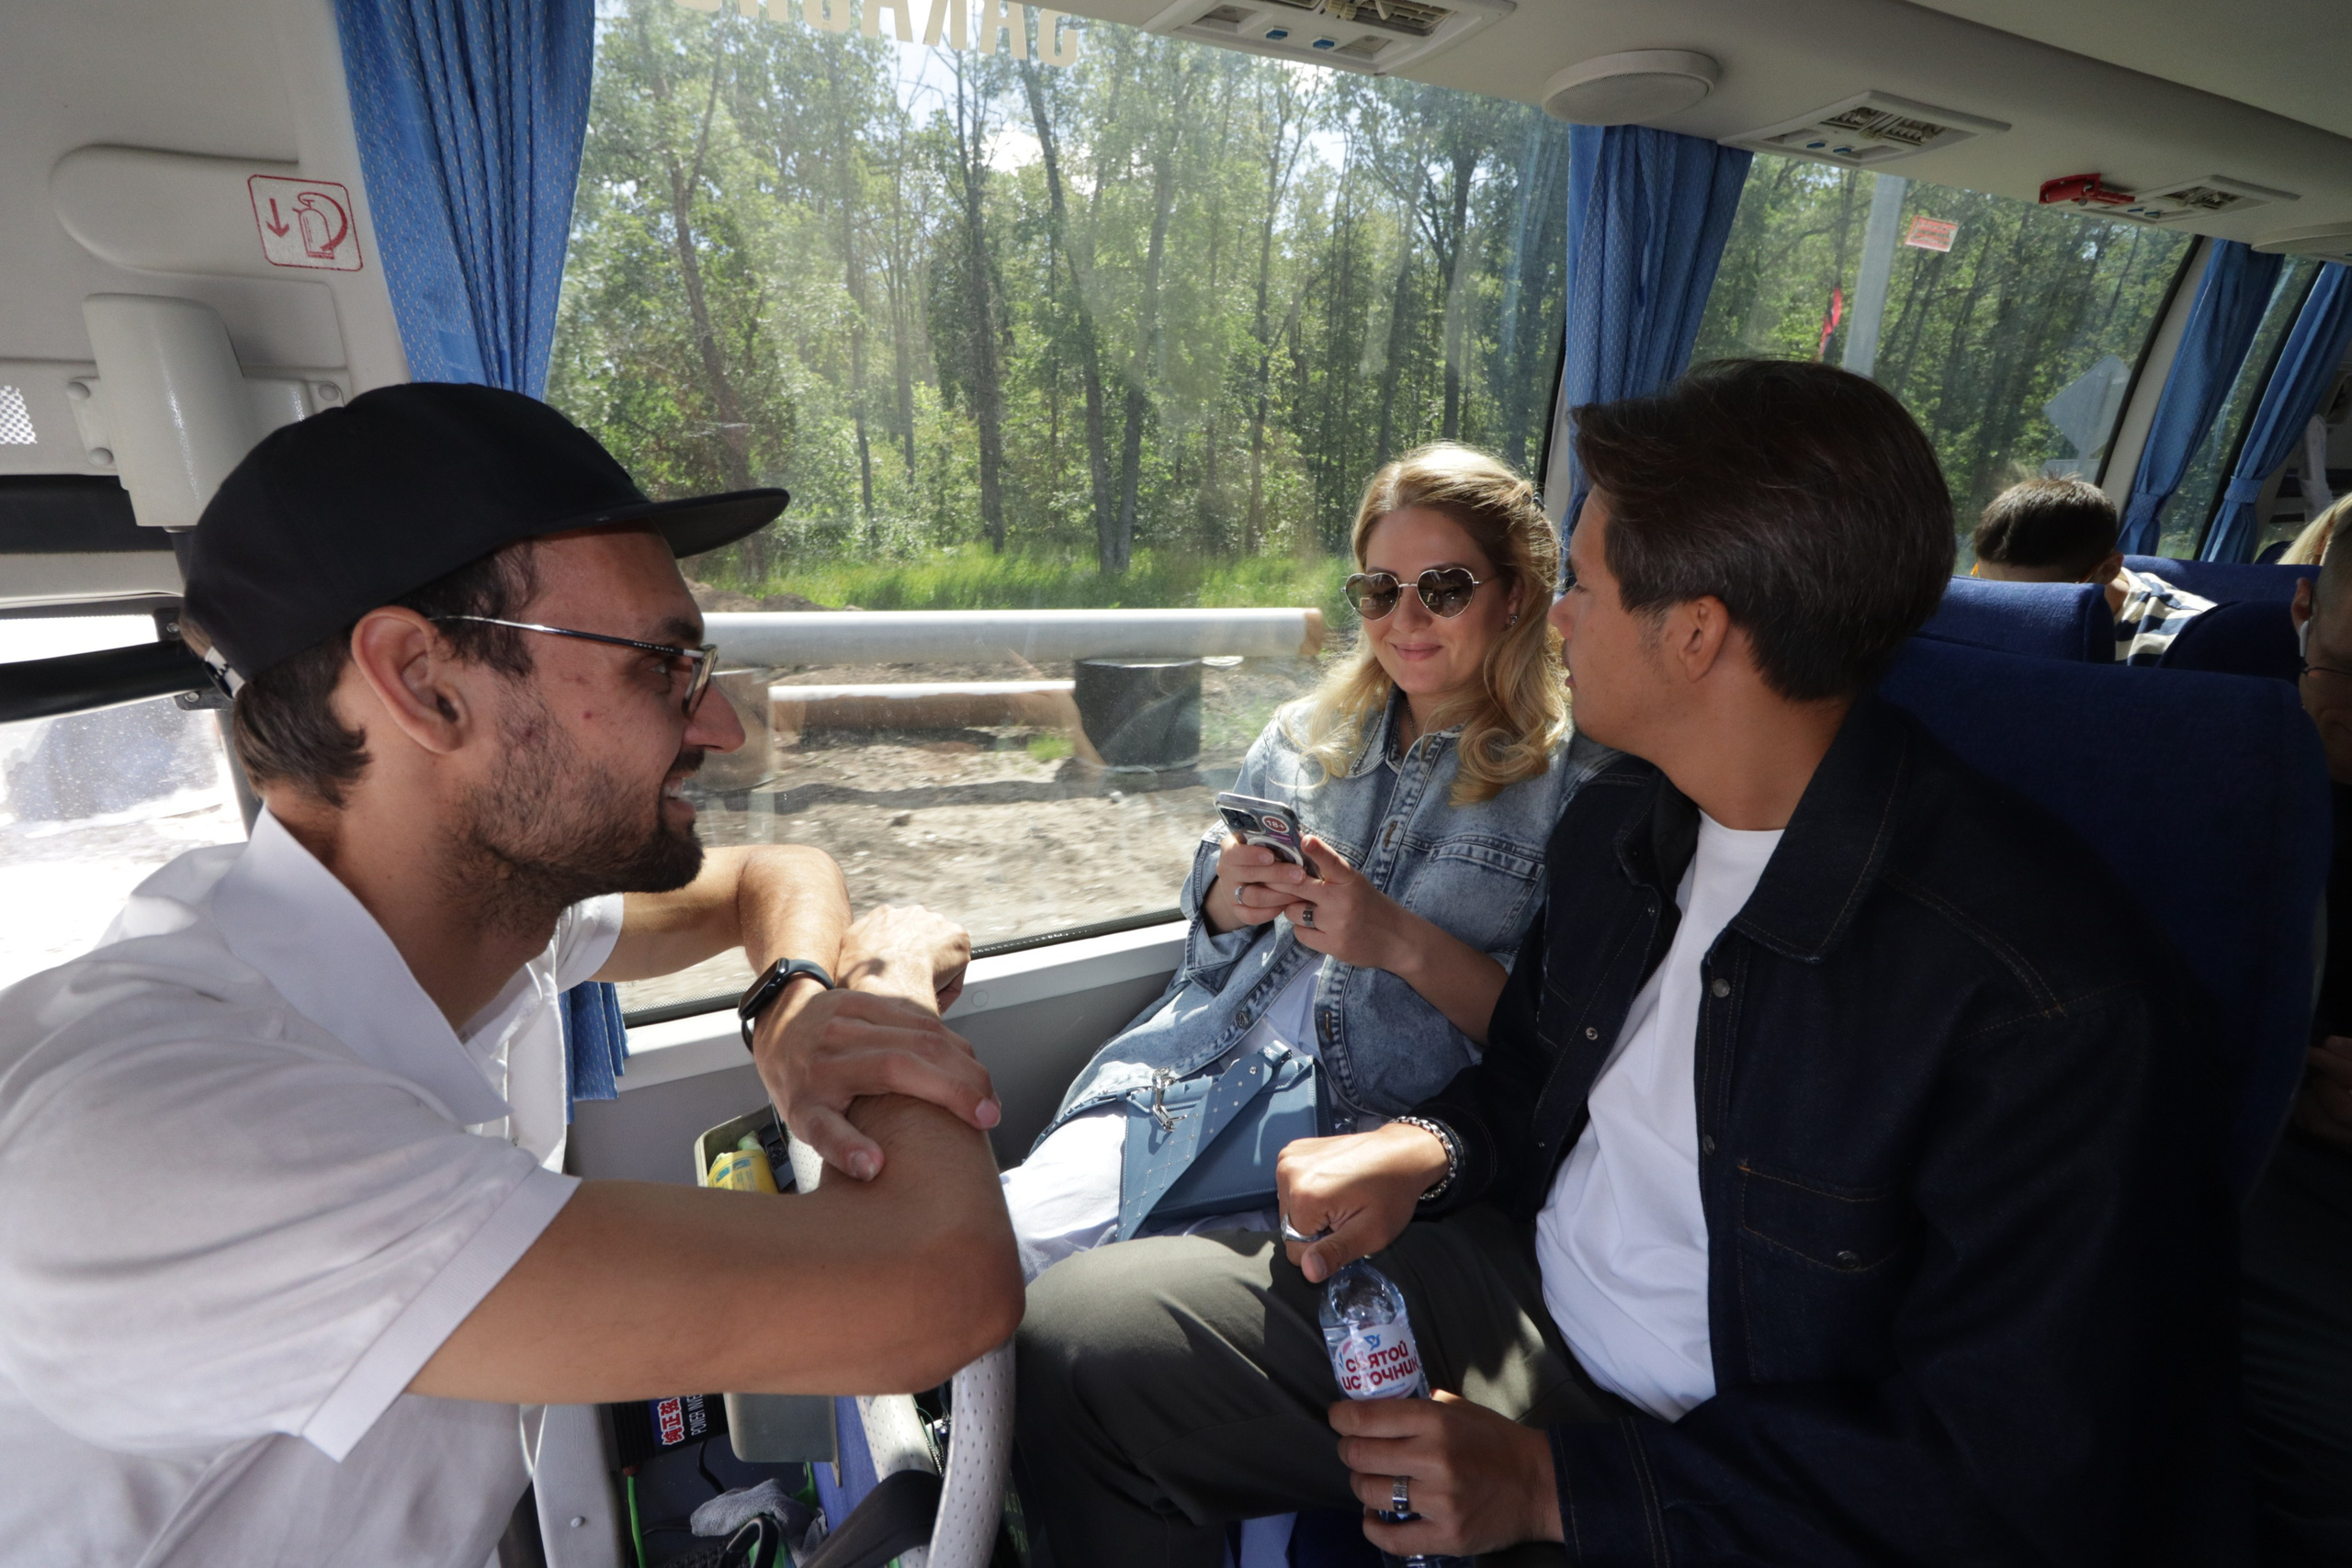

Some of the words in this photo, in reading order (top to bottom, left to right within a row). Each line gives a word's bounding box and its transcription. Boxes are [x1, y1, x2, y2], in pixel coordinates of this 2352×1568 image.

[1266, 819, 1286, 829] 18+
[1345, 1340, 1408, 1373] СВЯТОЙ
[686, 1393, 704, 1412] INVE
[658, 1397, 684, 1445] 纯正弦
[688, 1409, 707, 1436] POWER
